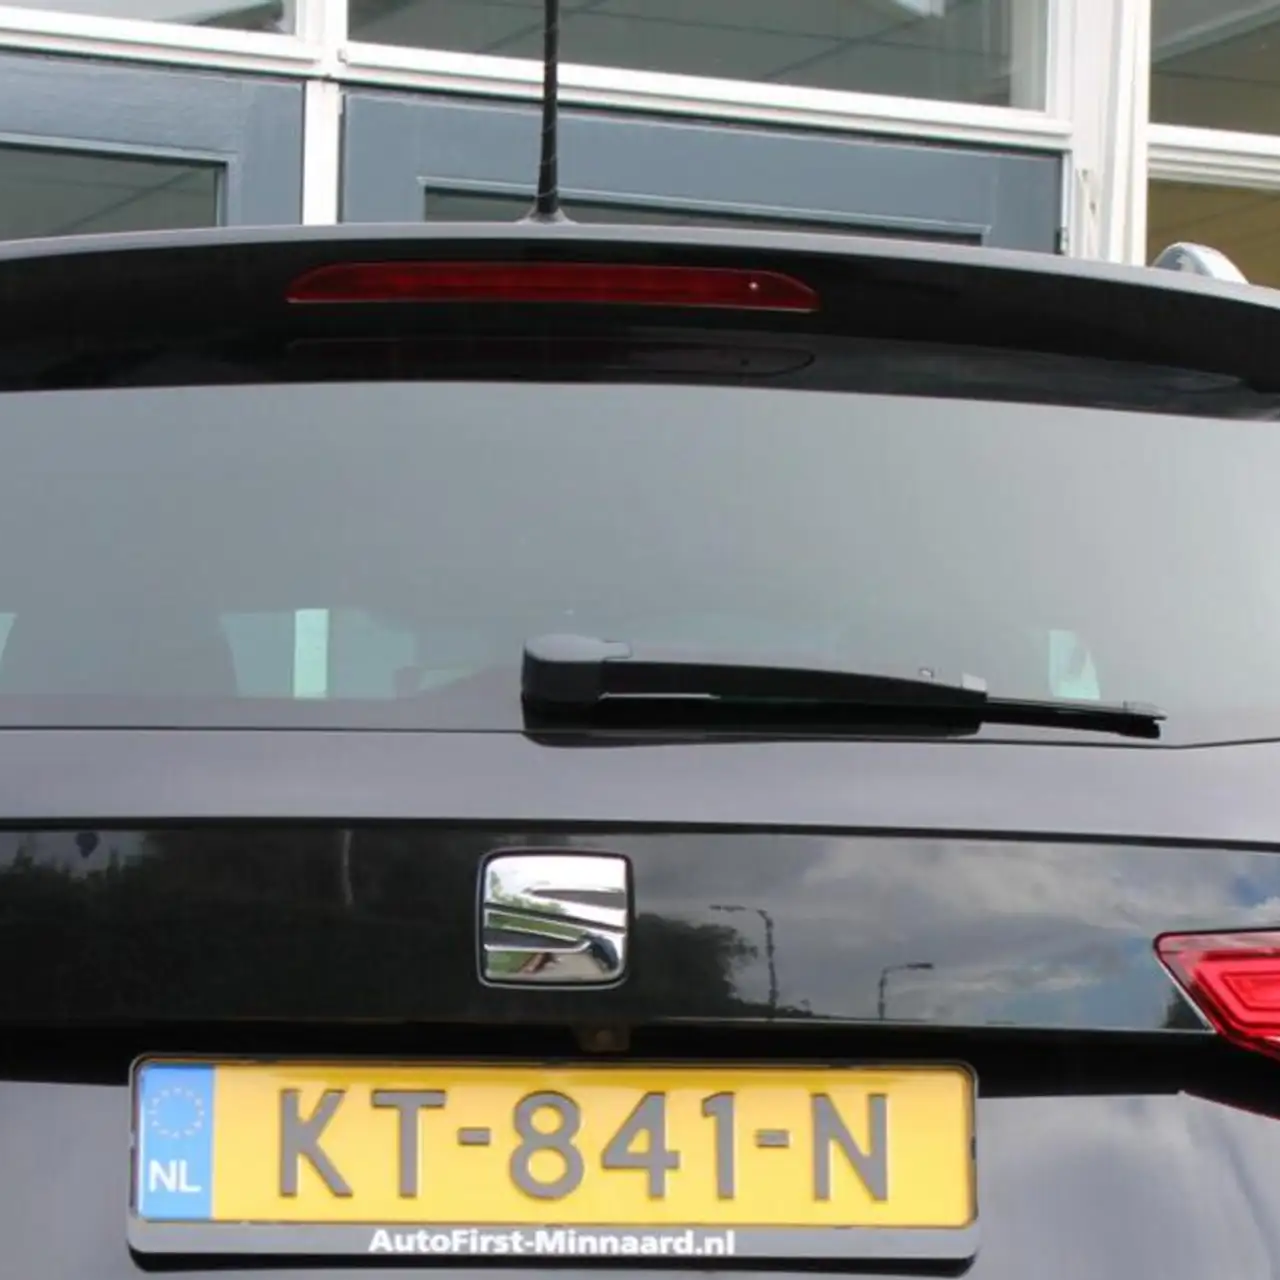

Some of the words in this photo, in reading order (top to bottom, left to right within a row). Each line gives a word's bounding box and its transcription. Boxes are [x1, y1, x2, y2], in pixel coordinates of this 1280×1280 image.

[277, 1087, 888, 1203] KT-841-N
[148, 1159, 203, 1193] NL
[368, 1228, 736, 1256] AutoFirst-Minnaard.nl
